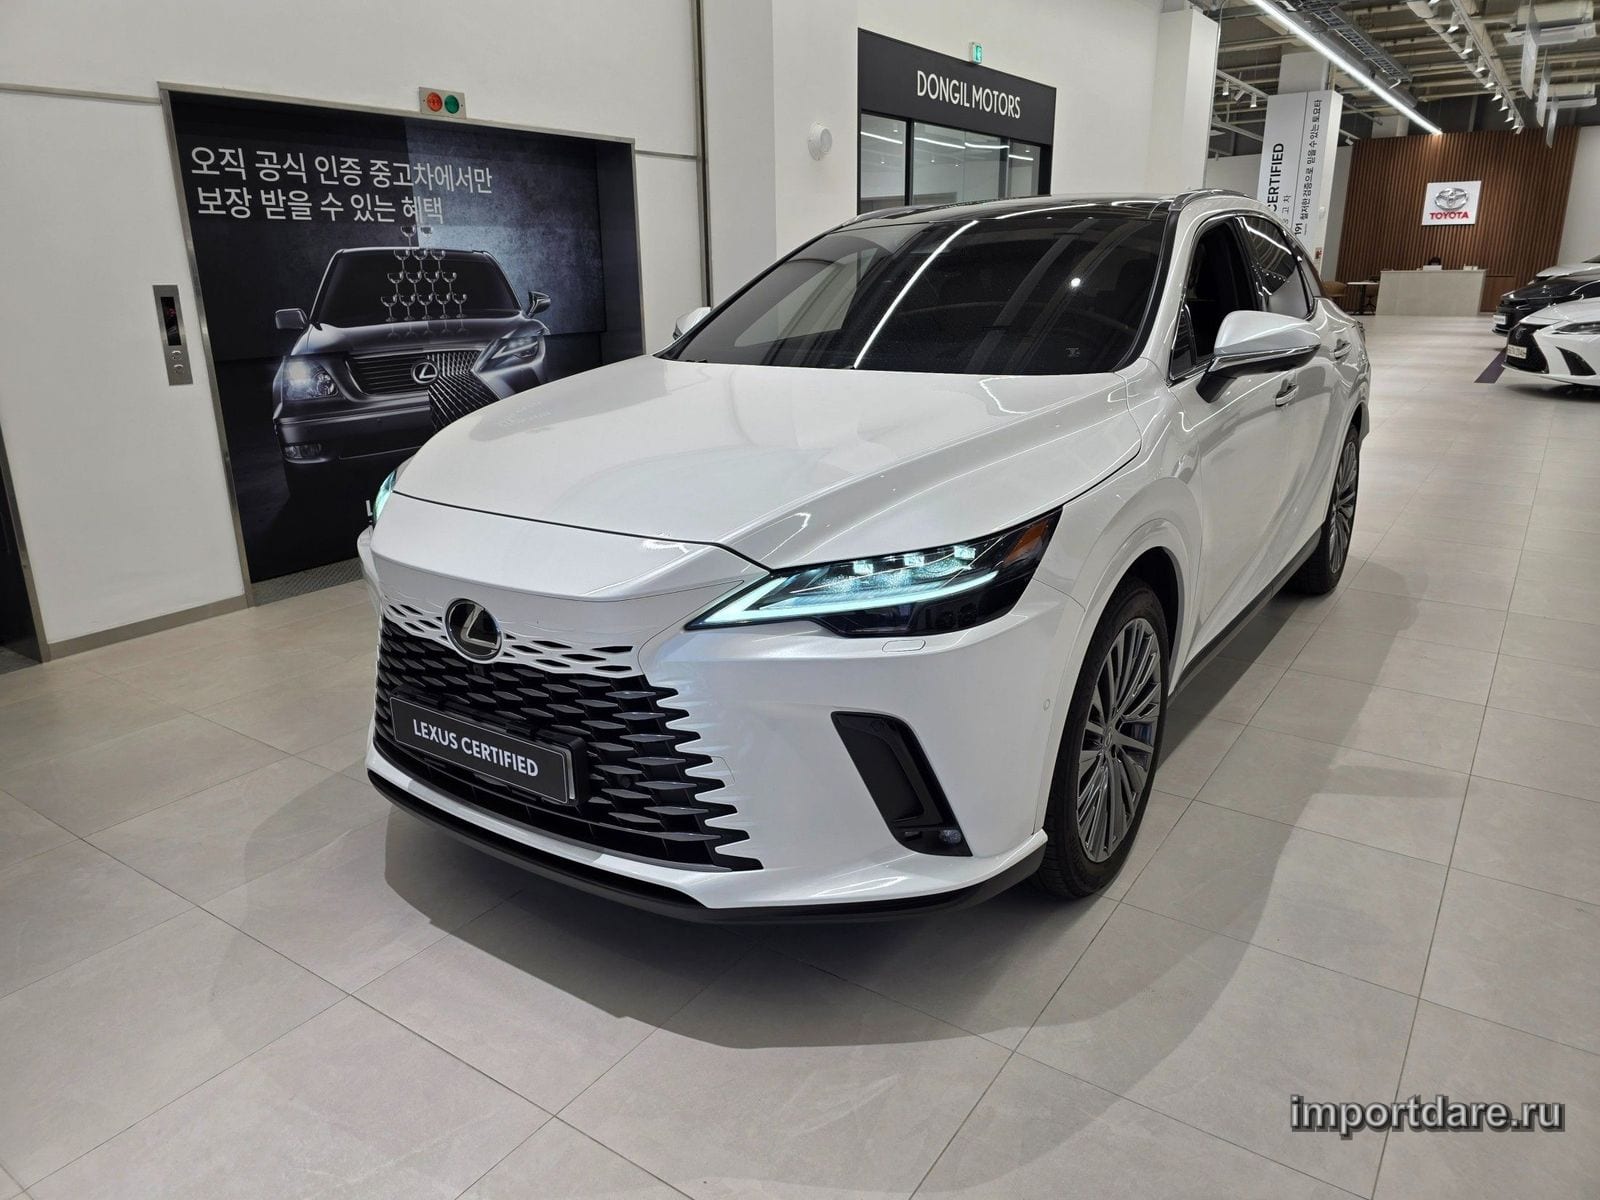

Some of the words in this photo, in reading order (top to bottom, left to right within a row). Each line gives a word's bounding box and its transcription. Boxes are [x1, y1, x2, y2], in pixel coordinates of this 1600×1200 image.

[916, 69, 970, 108] DONGIL
[972, 84, 1021, 119] MOTORS
[191, 146, 247, 181] 오직
[255, 150, 308, 184] 공식
[314, 155, 363, 187] 인증
[369, 159, 493, 194] 중고차에서만
[197, 186, 252, 219] 보장
[260, 188, 313, 221] 받을
[320, 192, 344, 222] 수
[350, 193, 396, 223] 있는
[401, 196, 444, 225] 혜택
[1429, 211, 1470, 220] TOYOTA
[412, 718, 459, 750] LEXUS
[460, 737, 539, 777] CERTIFIED
